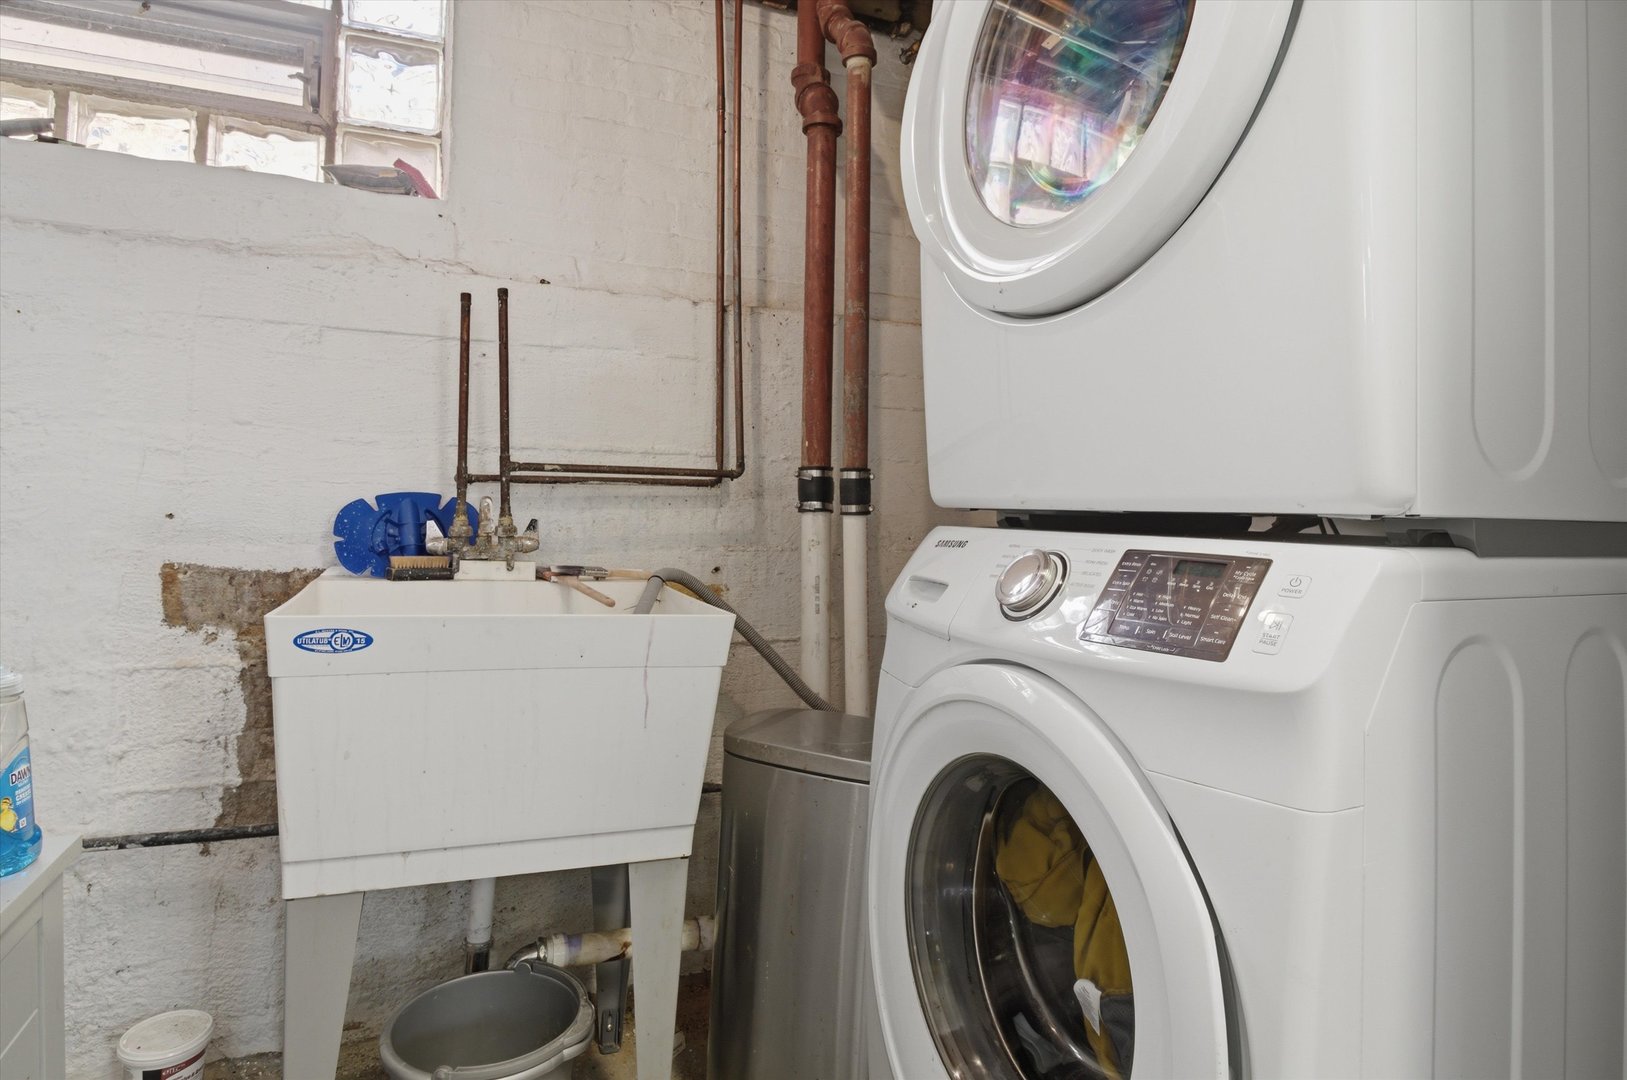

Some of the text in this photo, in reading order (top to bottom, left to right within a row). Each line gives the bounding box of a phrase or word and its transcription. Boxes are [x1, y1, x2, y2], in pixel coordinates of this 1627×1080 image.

[935, 540, 969, 549] SAMSUNG
[1262, 632, 1281, 640] START
[297, 637, 328, 645] UTILATUB
[1258, 639, 1279, 647] PAUSE
